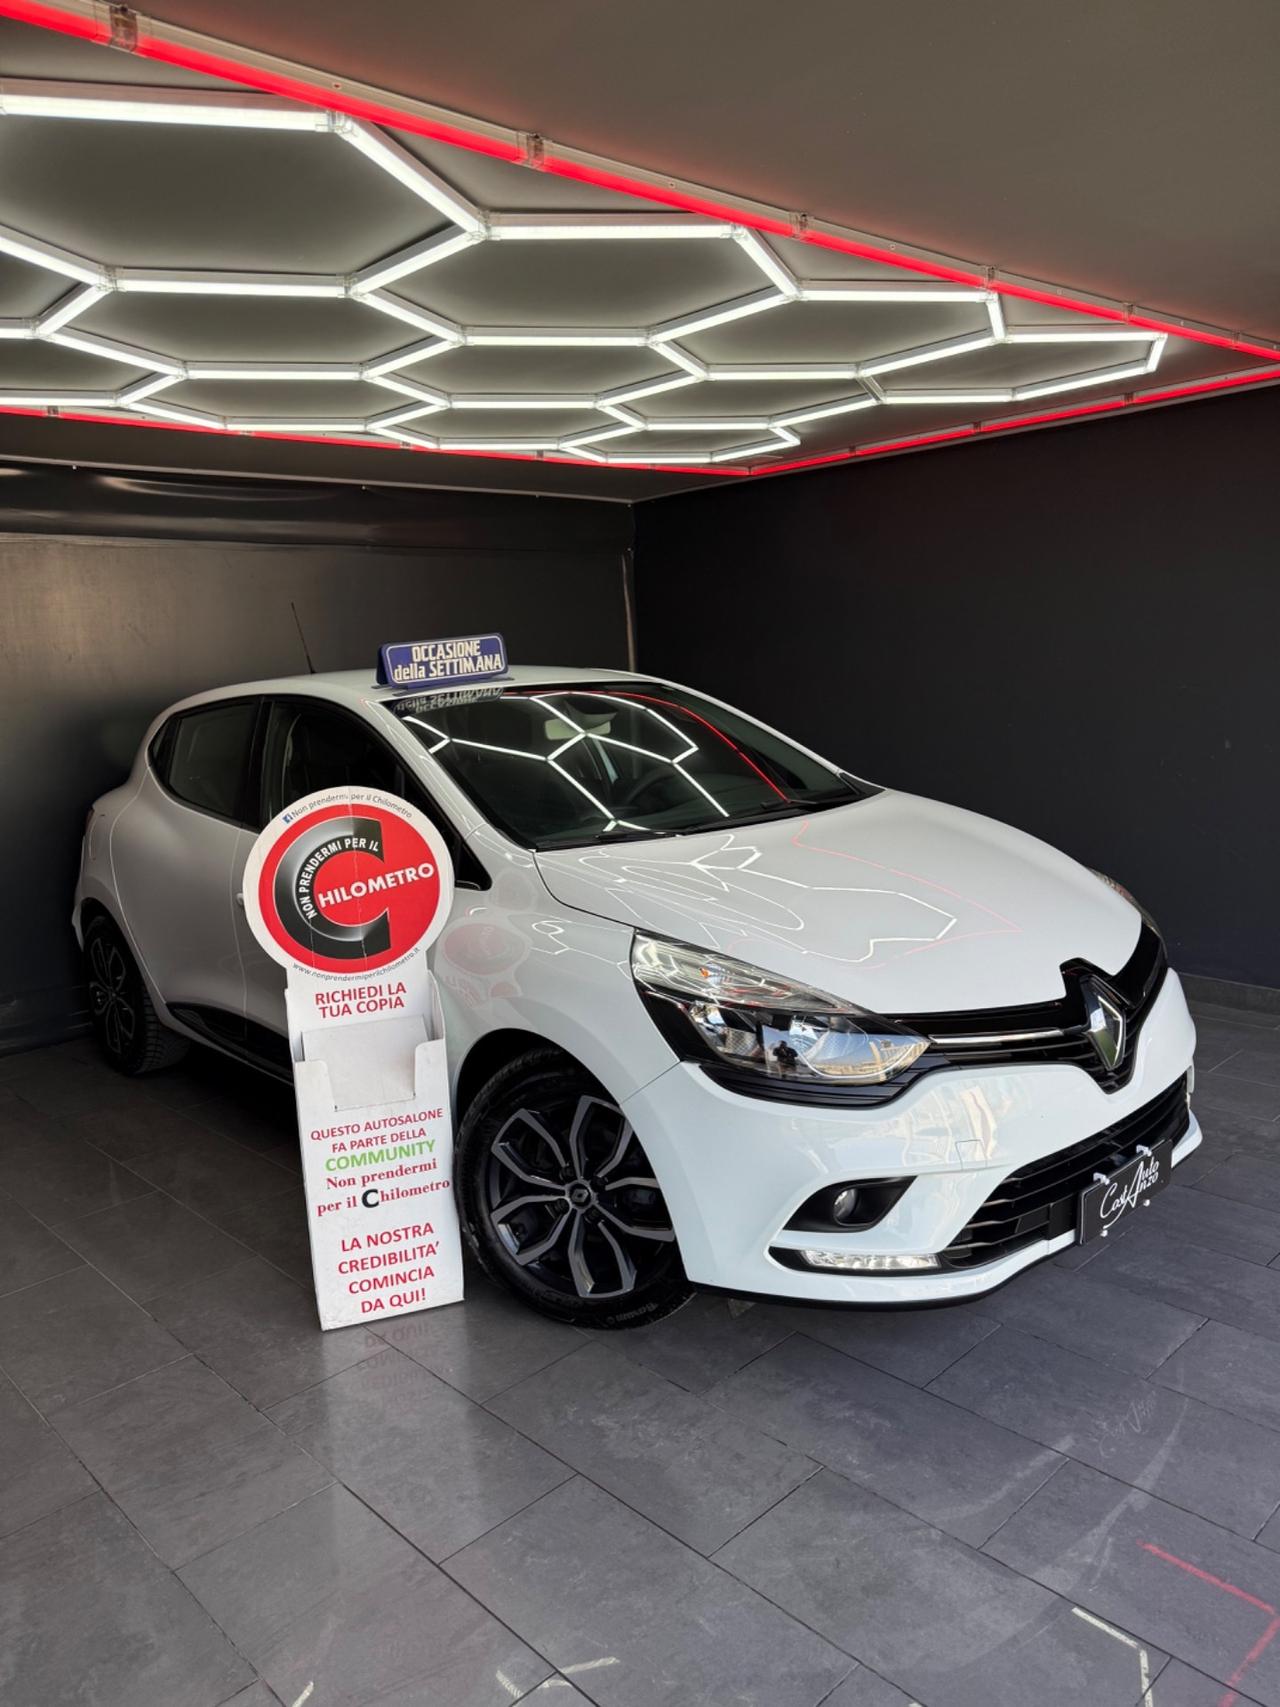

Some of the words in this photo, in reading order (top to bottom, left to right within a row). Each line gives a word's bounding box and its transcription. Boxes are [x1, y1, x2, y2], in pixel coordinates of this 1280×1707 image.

[411, 640, 482, 663] OCCASIONE
[393, 663, 426, 681] della
[428, 654, 502, 678] SETTIMANA
[291, 805, 308, 818] Non
[309, 794, 350, 810] prendermi
[373, 795, 413, 819] Chilometro
[344, 836, 367, 849] PER
[369, 840, 380, 852] IL
[299, 839, 343, 894] PRENDERMI
[299, 894, 318, 920] NON
[315, 984, 383, 1006] RICHIEDI
[387, 981, 407, 995] LA
[318, 1003, 352, 1019] TUA
[356, 996, 405, 1014] COPIA
[310, 1124, 361, 1141] QUESTO
[363, 1108, 444, 1132] AUTOSALONE
[331, 1140, 347, 1154] FA
[350, 1134, 387, 1150] PARTE
[390, 1128, 427, 1143] DELLA
[325, 1139, 436, 1172] COMMUNITY
[325, 1175, 357, 1190] Non
[361, 1159, 438, 1188] prendermi
[316, 1201, 343, 1217] per
[346, 1196, 358, 1210] il
[341, 1237, 362, 1252] LA
[366, 1222, 434, 1247] NOSTRA
[348, 1265, 435, 1294] COMINCIA
[361, 1298, 385, 1313] DA
[389, 1287, 426, 1308] QUI!
